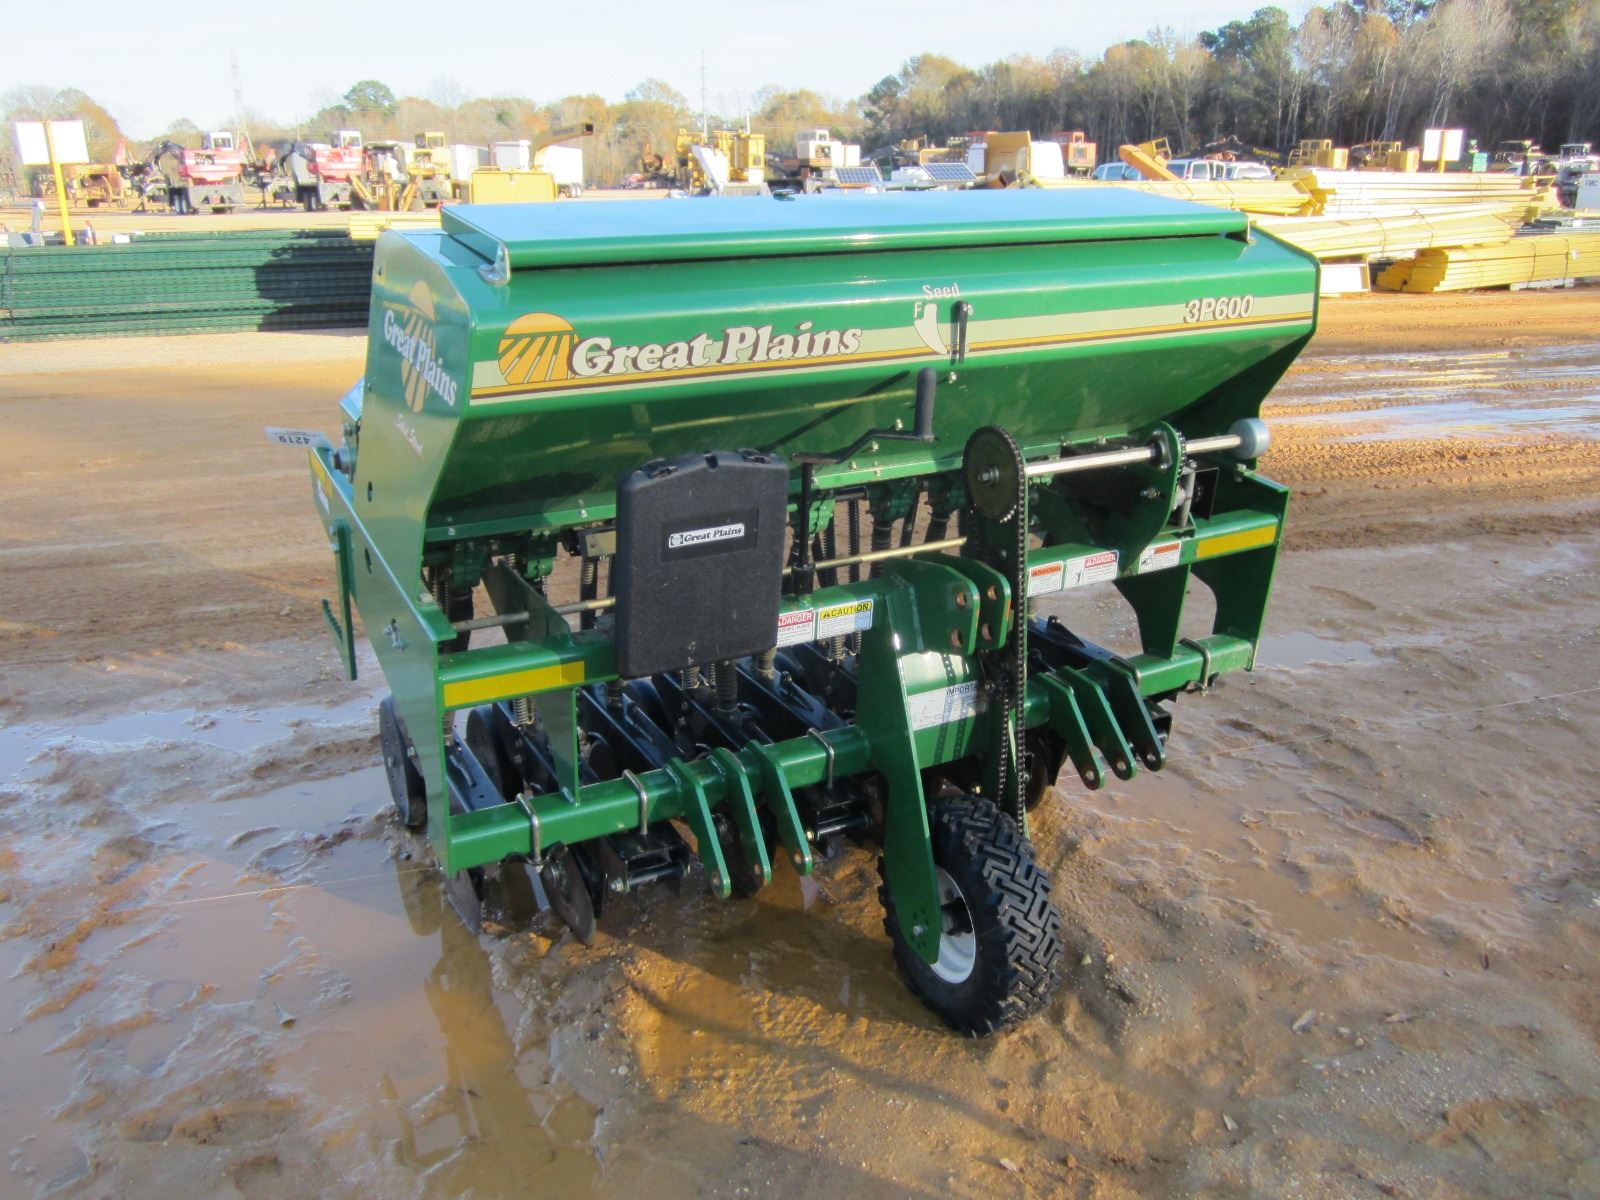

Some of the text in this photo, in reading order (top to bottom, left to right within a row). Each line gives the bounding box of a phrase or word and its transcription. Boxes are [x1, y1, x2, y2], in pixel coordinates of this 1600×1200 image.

[922, 283, 961, 299] Seed
[914, 302, 922, 318] F
[1183, 295, 1254, 324] 3P600
[570, 321, 862, 376] Great Plains
[384, 310, 457, 406] Great Plains
[684, 526, 742, 543] Great Plains
[831, 602, 869, 617] CAUTION
[781, 612, 812, 626] DANGER
